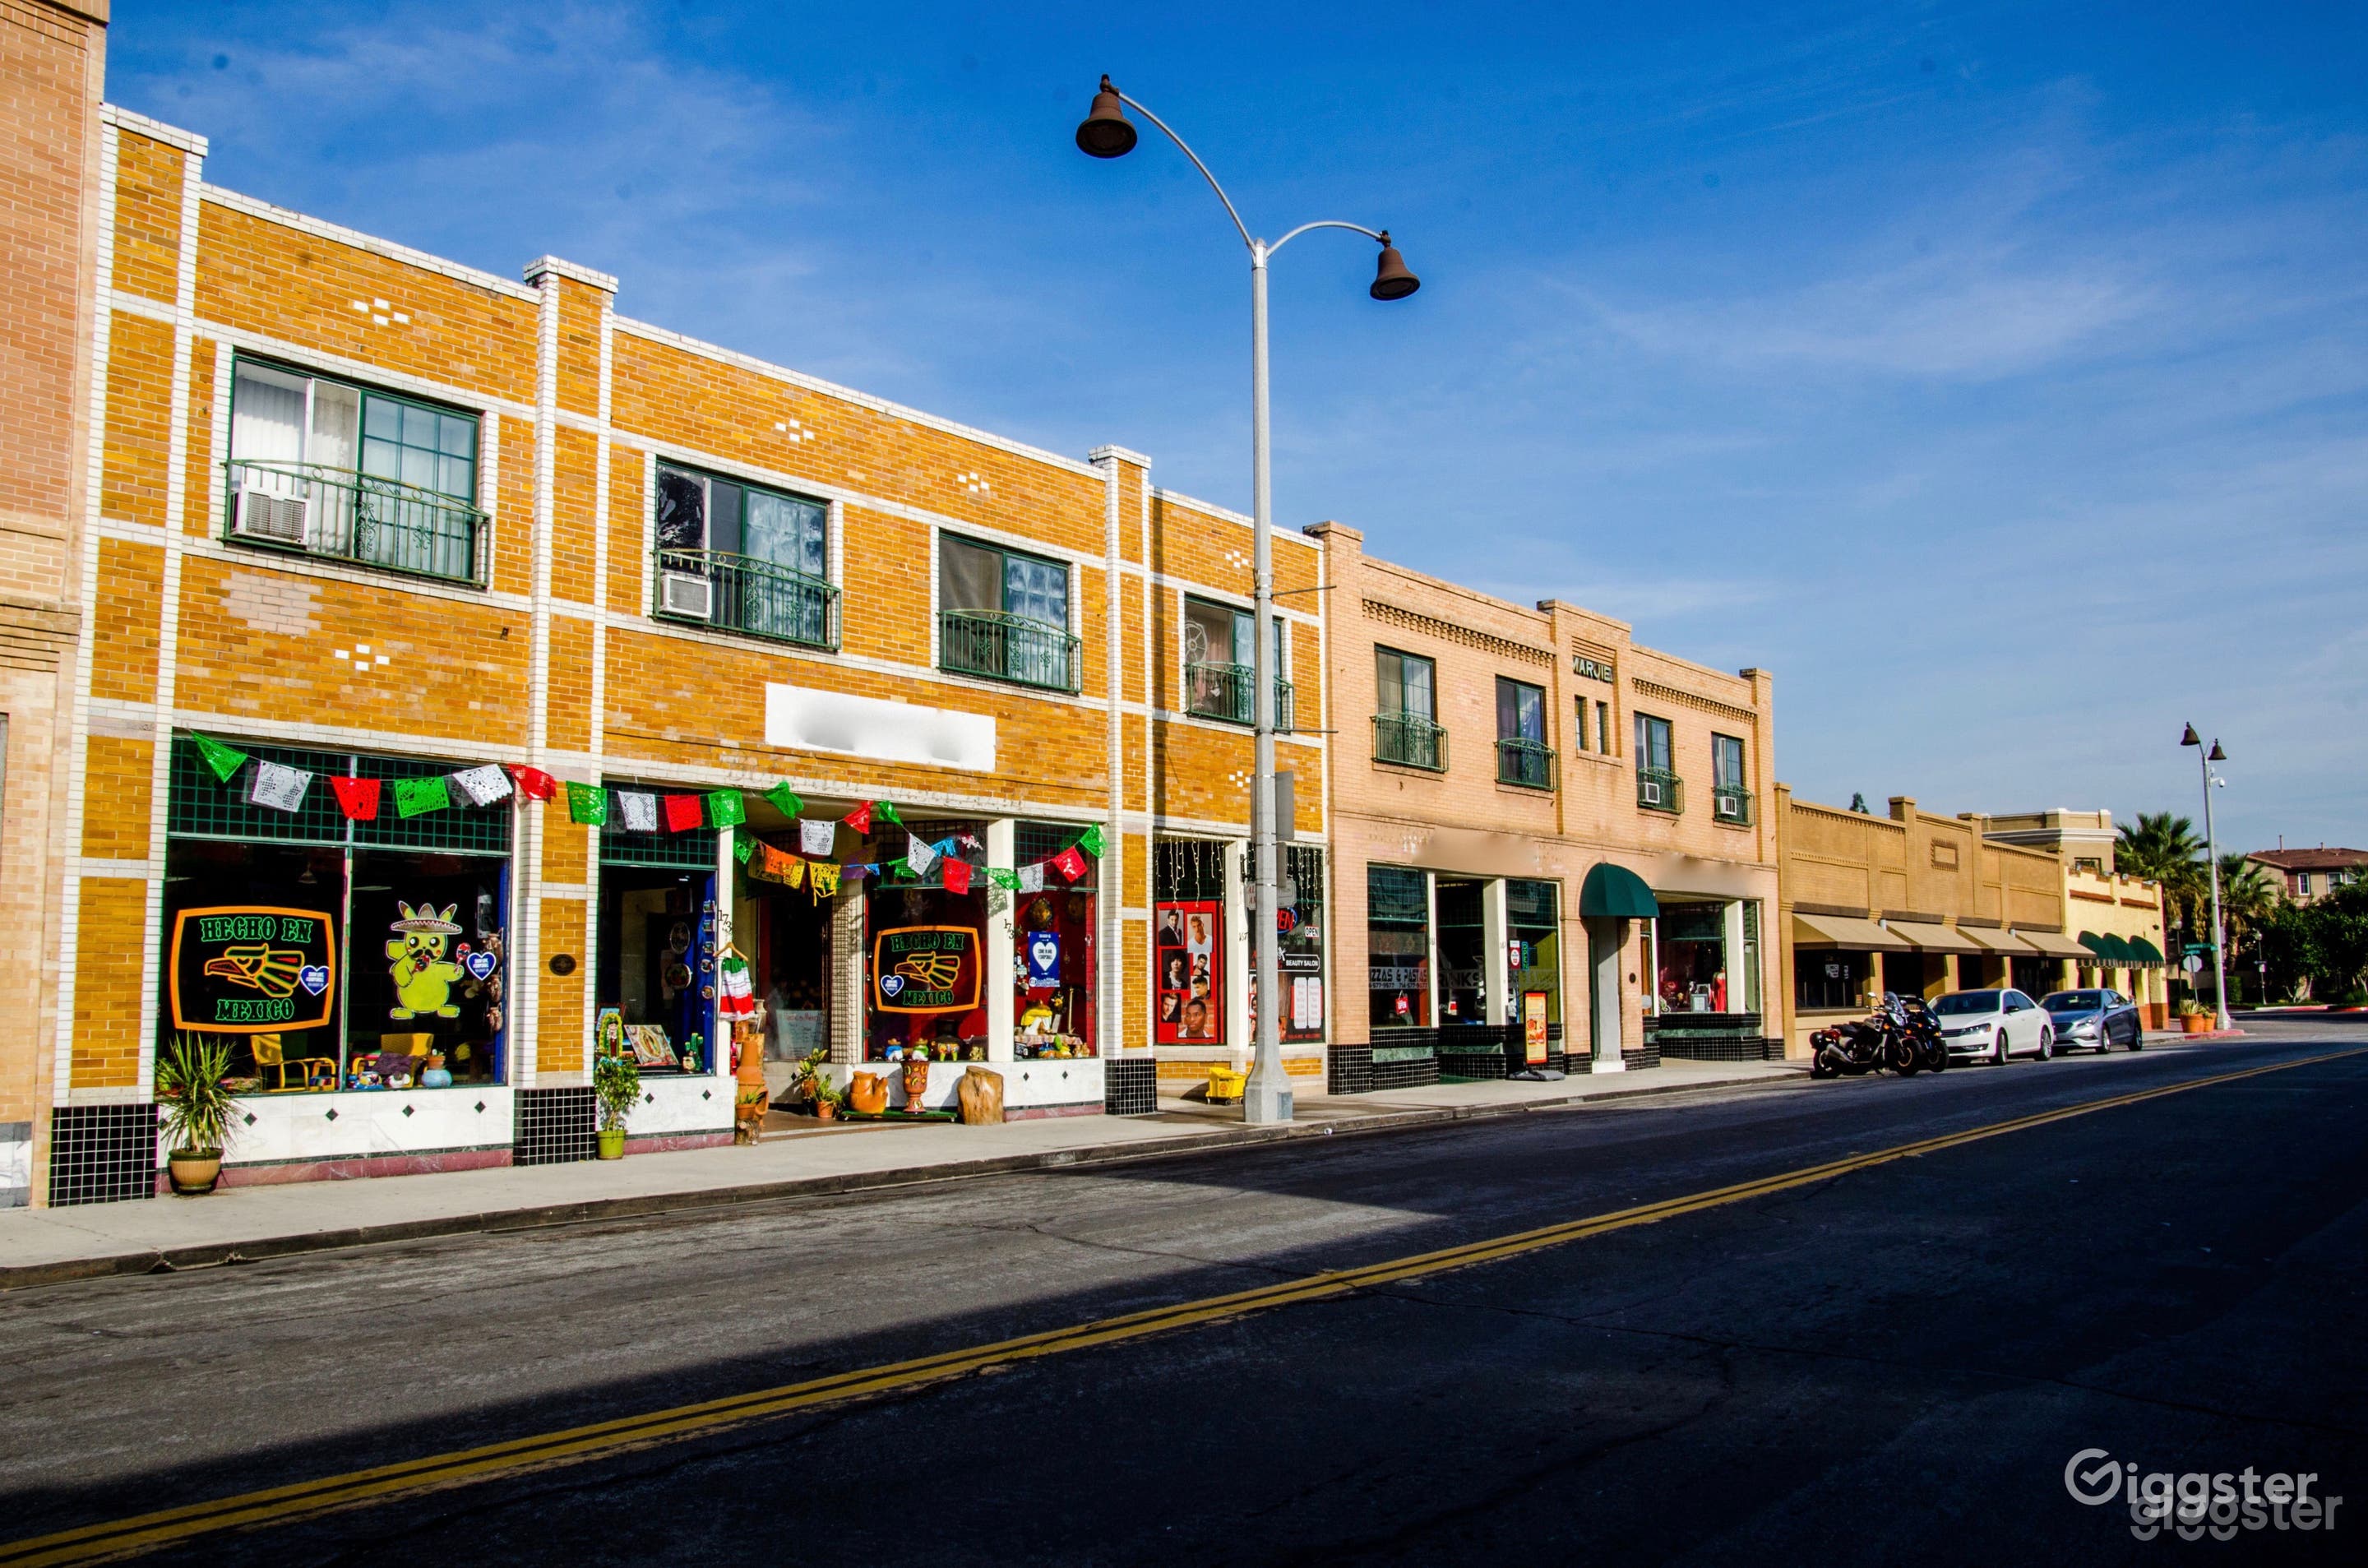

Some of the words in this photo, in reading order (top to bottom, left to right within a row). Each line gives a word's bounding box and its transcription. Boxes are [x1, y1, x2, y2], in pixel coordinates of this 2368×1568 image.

[200, 917, 276, 942] HECHO
[281, 918, 313, 942] EN
[1305, 927, 1319, 937] OPEN
[890, 933, 940, 952] HECHO
[944, 933, 964, 950] EN
[1404, 969, 1427, 982] PASTAS
[1438, 973, 1479, 987] RINKS
[903, 989, 954, 1006] MEXICO
[215, 998, 294, 1021] MEXICO
